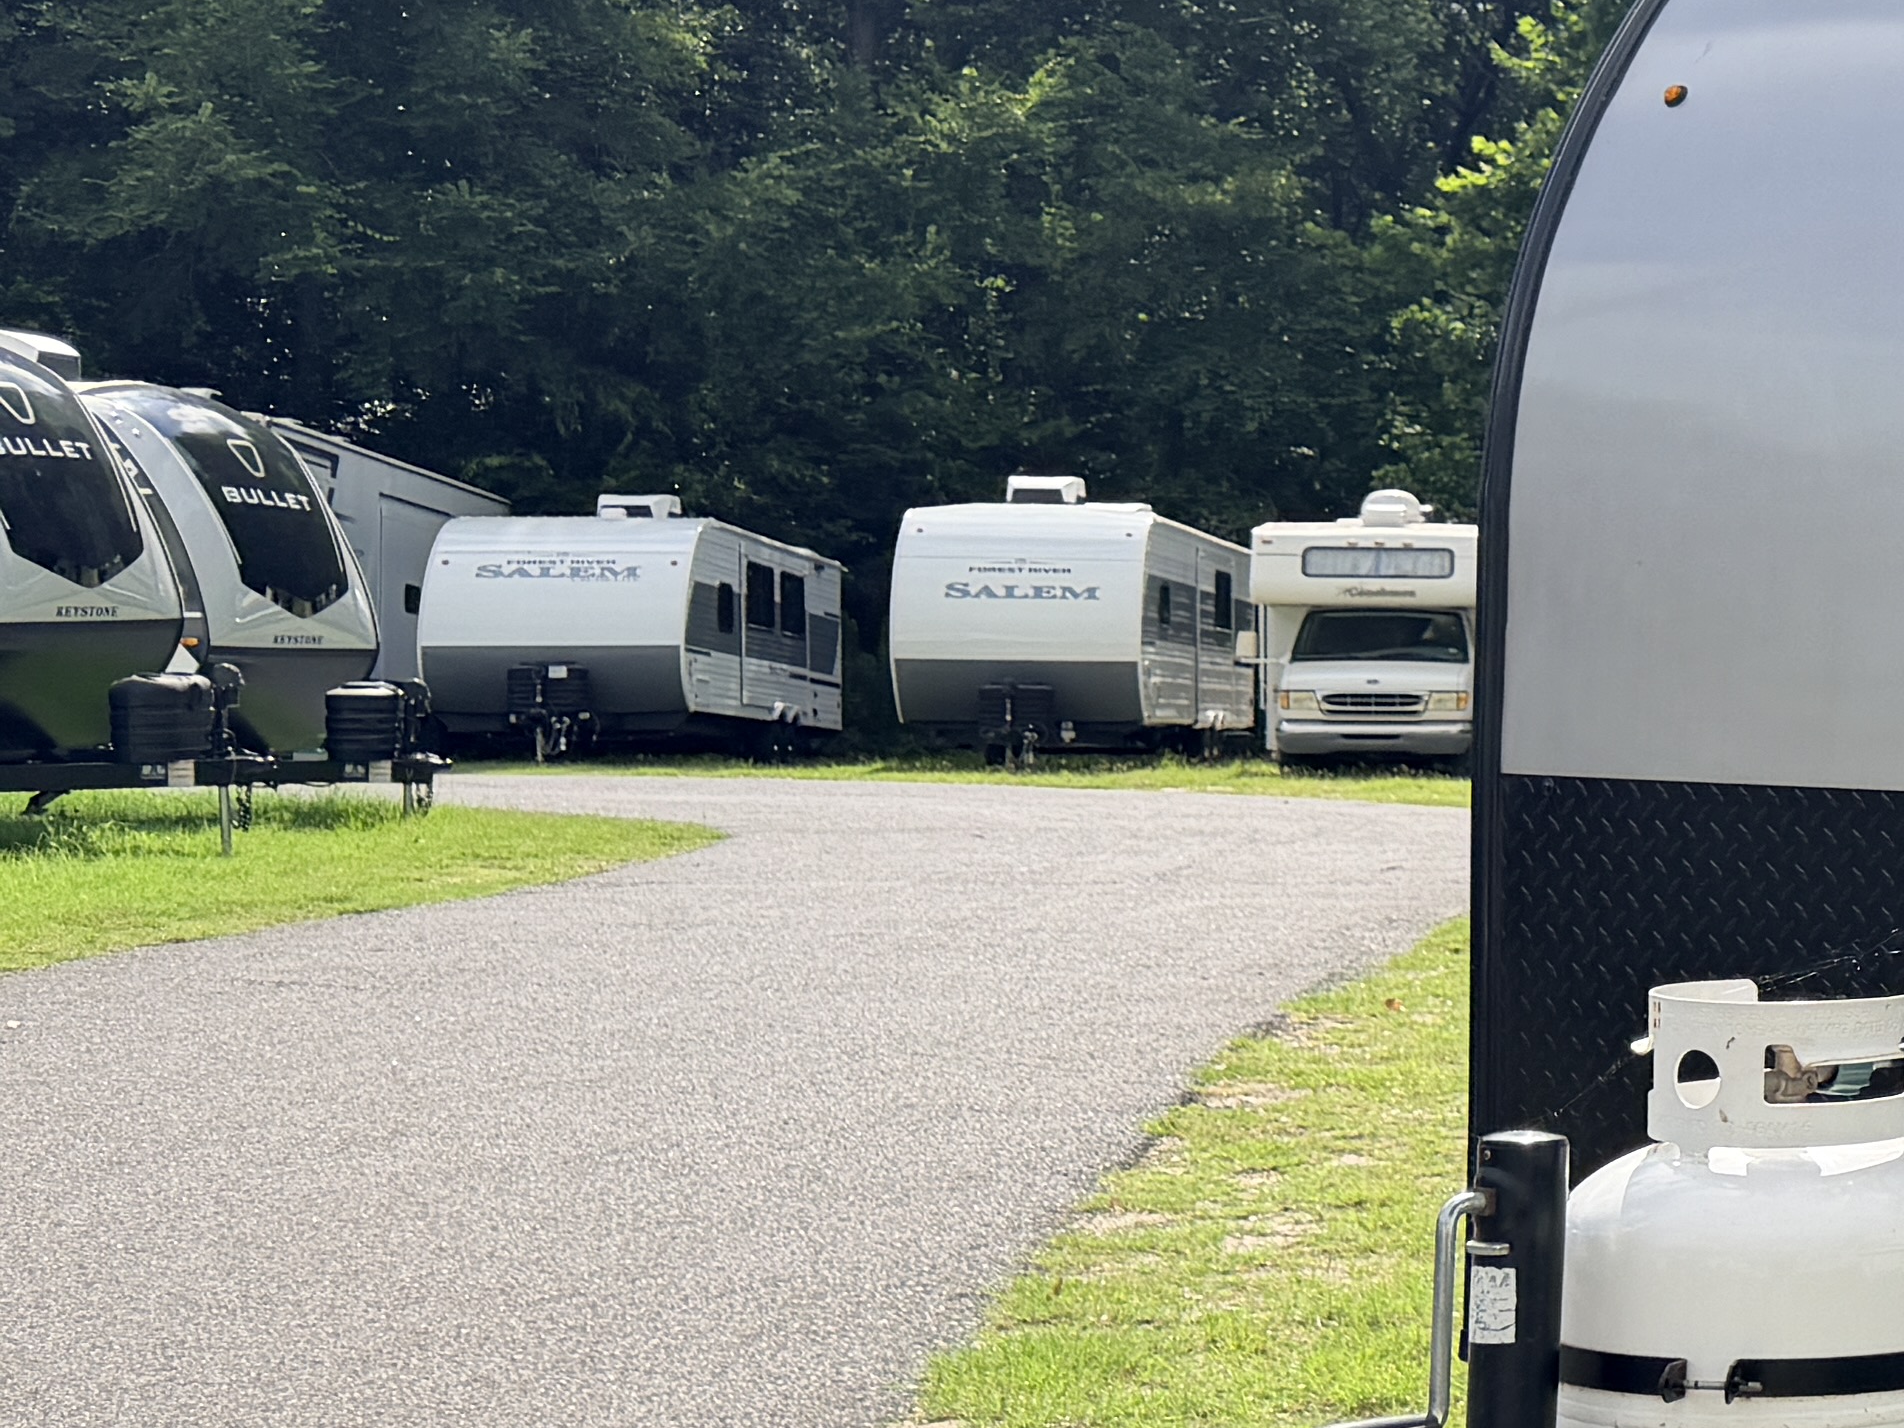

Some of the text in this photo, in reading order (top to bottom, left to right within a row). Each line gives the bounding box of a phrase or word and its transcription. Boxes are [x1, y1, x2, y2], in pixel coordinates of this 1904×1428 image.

[0, 436, 93, 460] ULLET
[221, 485, 312, 512] BULLET
[944, 582, 1101, 600] SALEM
[56, 606, 118, 617] KEYSTONE
